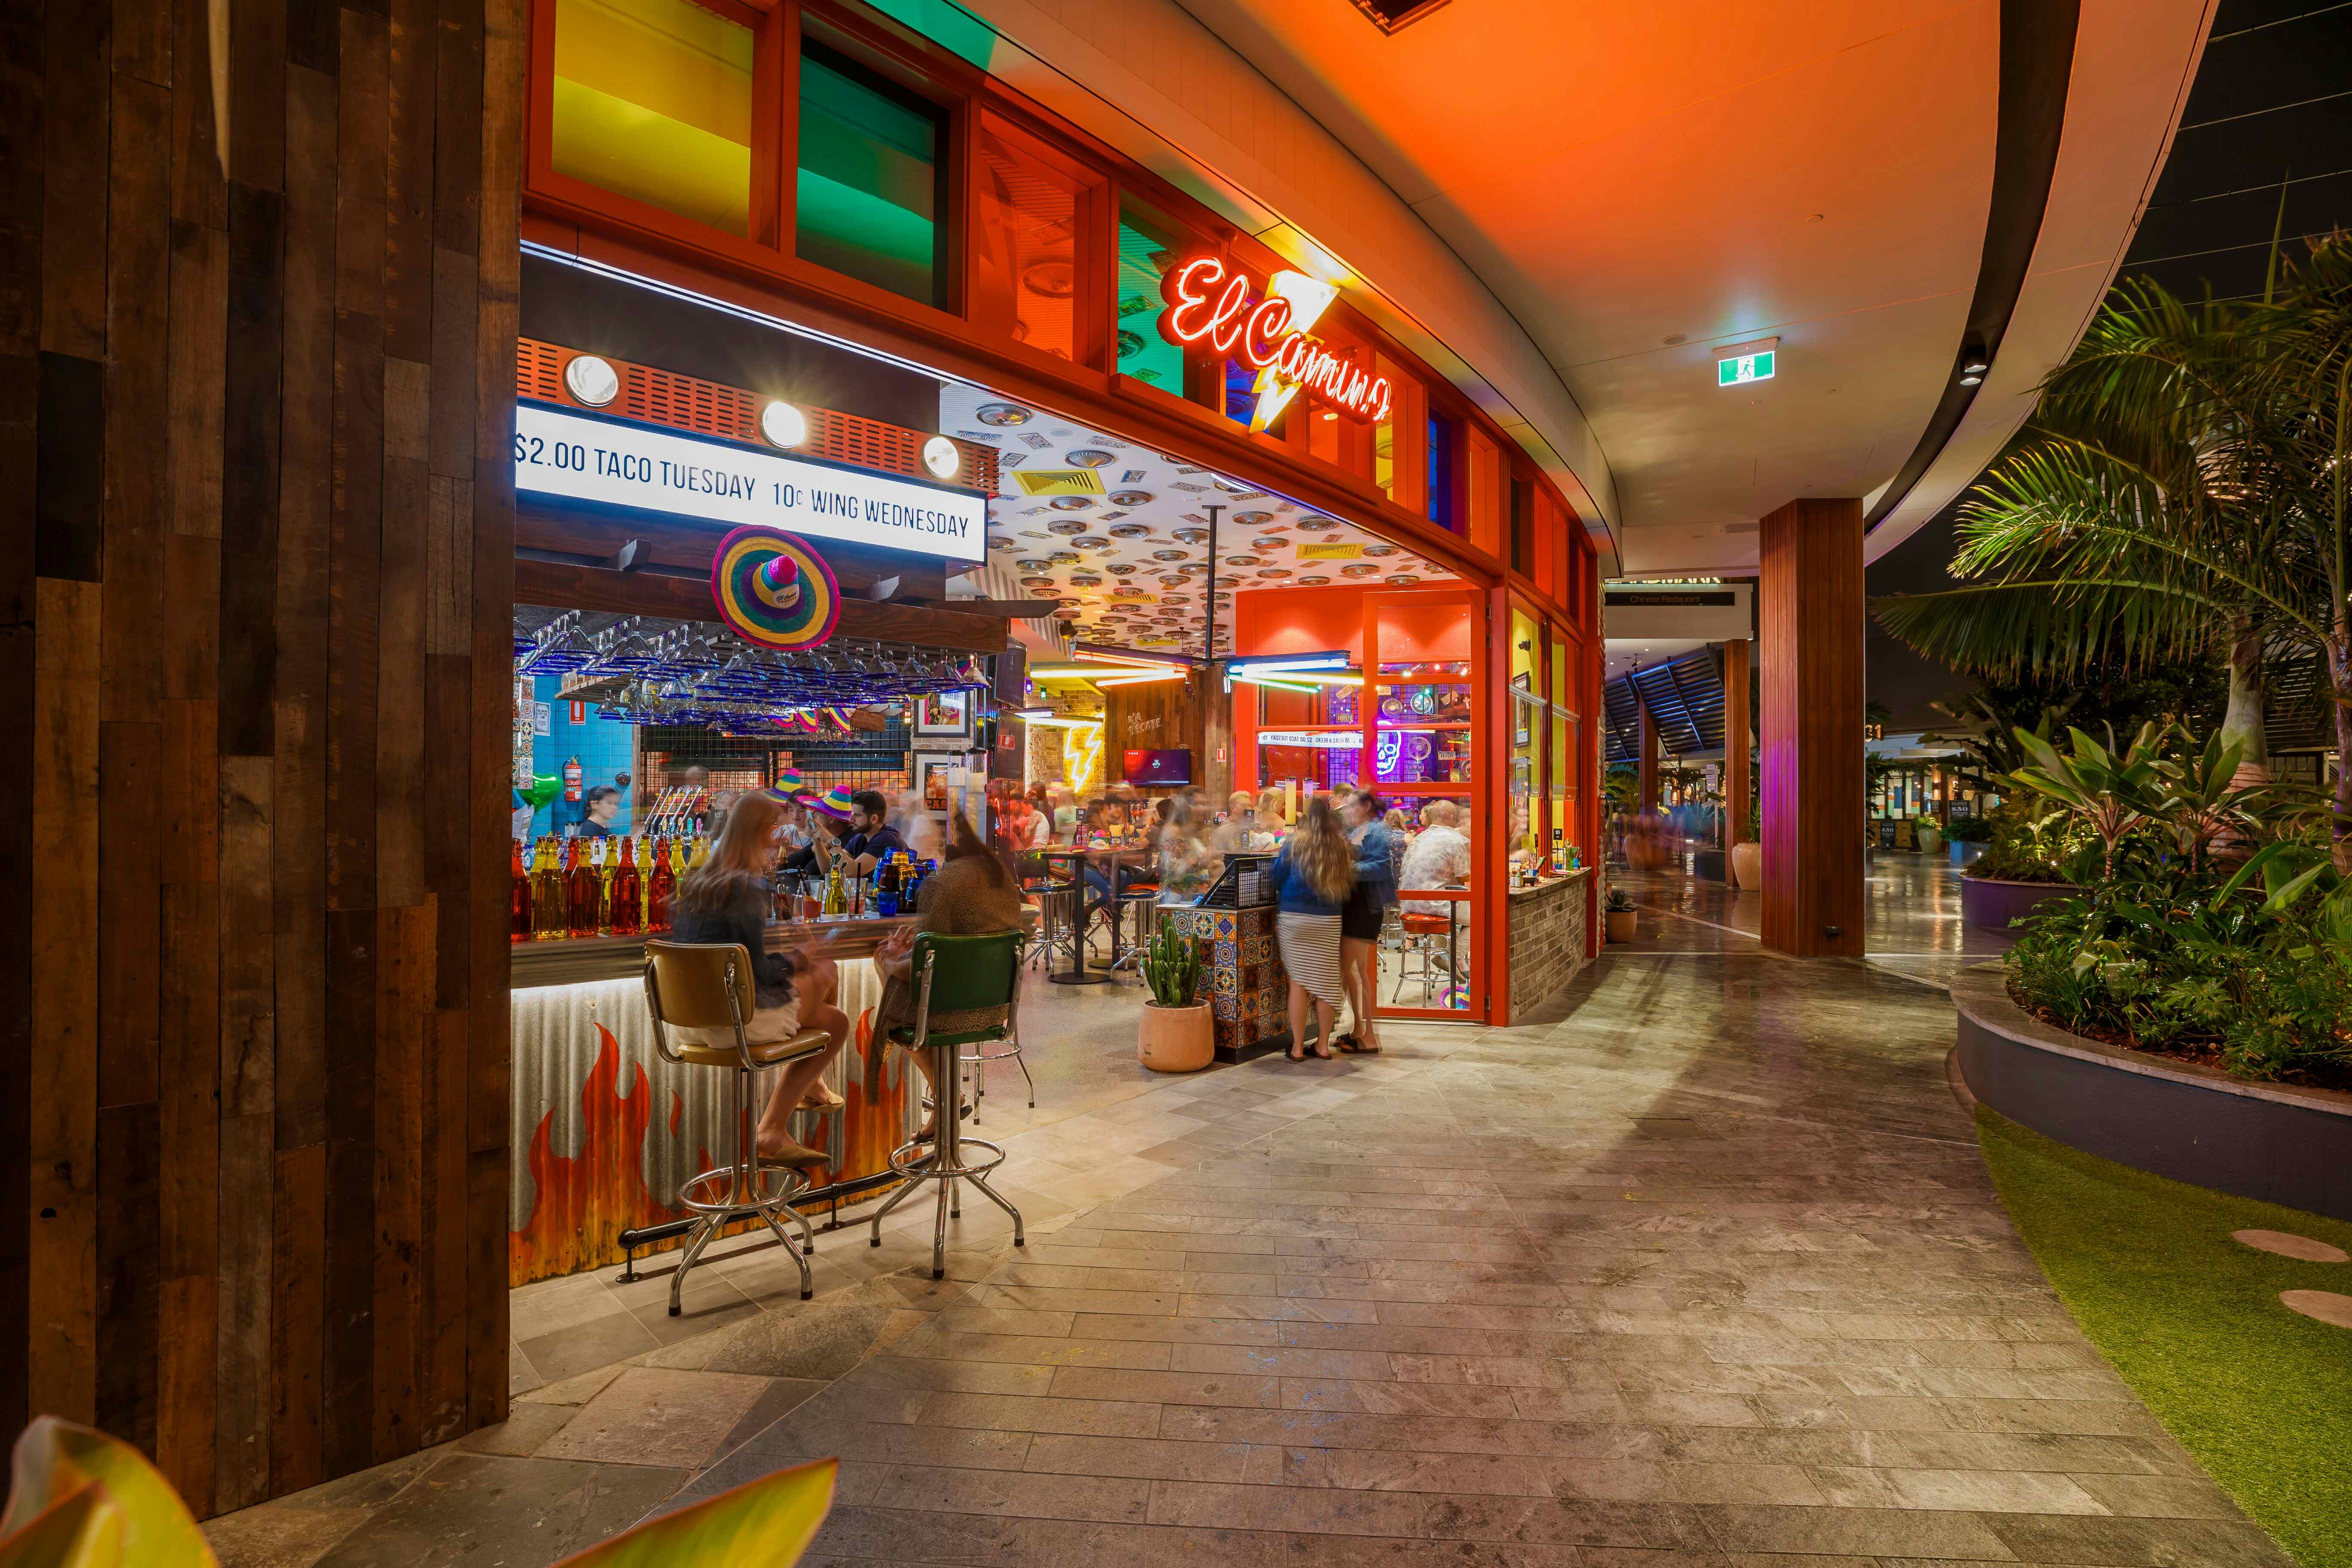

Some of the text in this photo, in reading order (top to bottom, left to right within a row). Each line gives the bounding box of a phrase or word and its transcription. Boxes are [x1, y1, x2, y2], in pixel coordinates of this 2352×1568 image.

[1171, 258, 1250, 352] El
[516, 432, 585, 471] $2.00
[594, 448, 651, 483] TACO
[660, 460, 755, 500] TUESDAY
[811, 489, 858, 519] WING
[865, 499, 969, 538] WEDNESDAY
[1630, 595, 1700, 603] Chinese Restaurant
[1128, 717, 1163, 736] TECATE
